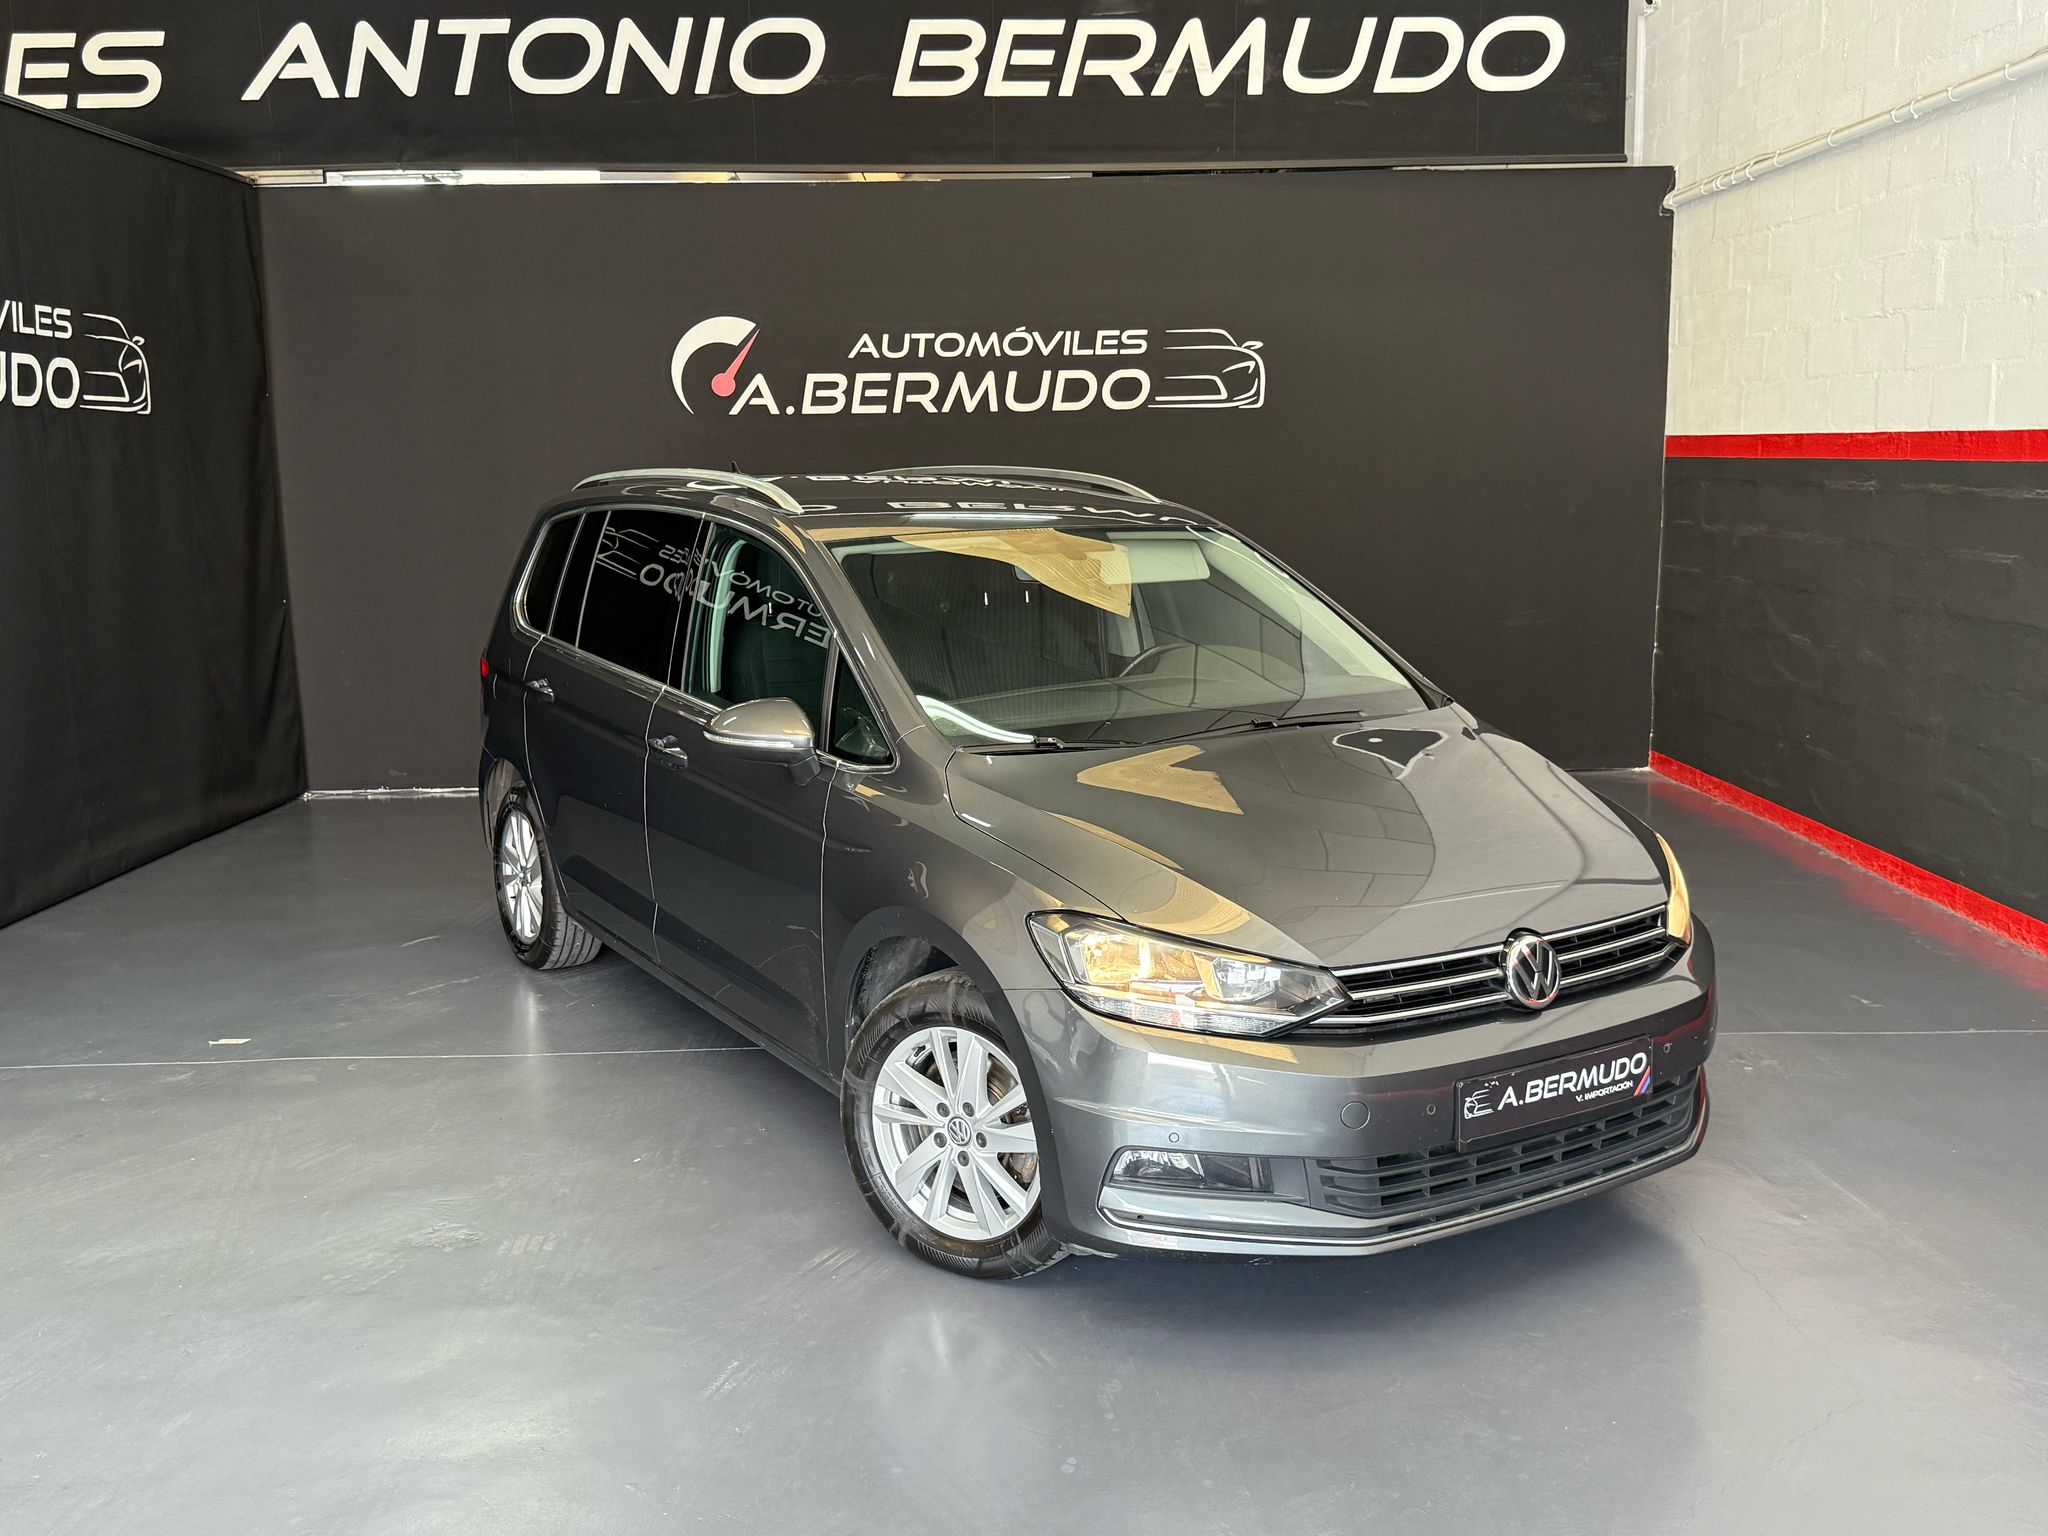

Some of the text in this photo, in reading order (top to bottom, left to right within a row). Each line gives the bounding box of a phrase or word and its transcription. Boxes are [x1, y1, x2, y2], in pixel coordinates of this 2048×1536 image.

[241, 17, 826, 101] ANTONIO
[892, 16, 1566, 98] BERMUDO
[848, 326, 1149, 359] AUTOMÓVILES
[0, 351, 80, 409] DO
[728, 369, 1151, 416] A.BERMUDO
[1497, 1052, 1648, 1111] A.BERMUDO
